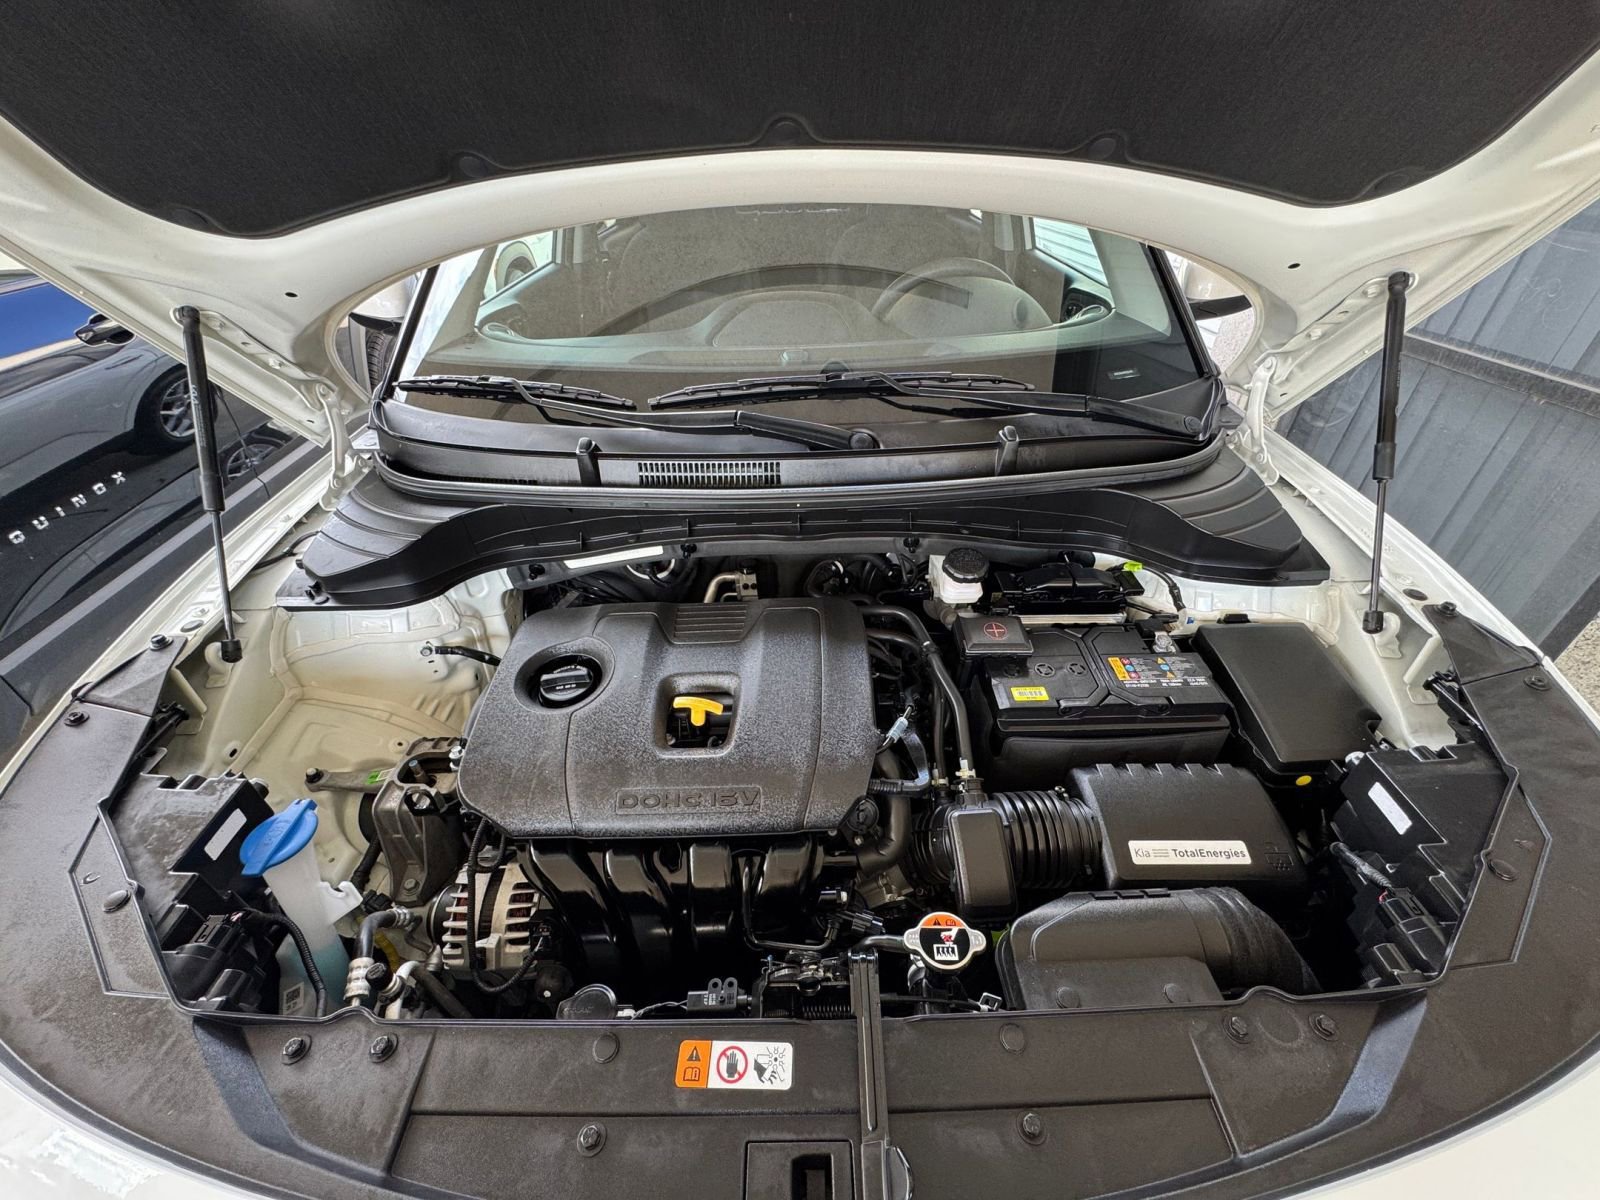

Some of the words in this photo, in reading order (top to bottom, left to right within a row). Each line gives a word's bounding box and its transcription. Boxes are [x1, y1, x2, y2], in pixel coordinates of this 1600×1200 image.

[618, 791, 702, 809] DOHC
[1134, 848, 1151, 858] Kia
[1171, 848, 1247, 860] TotalEnergies
